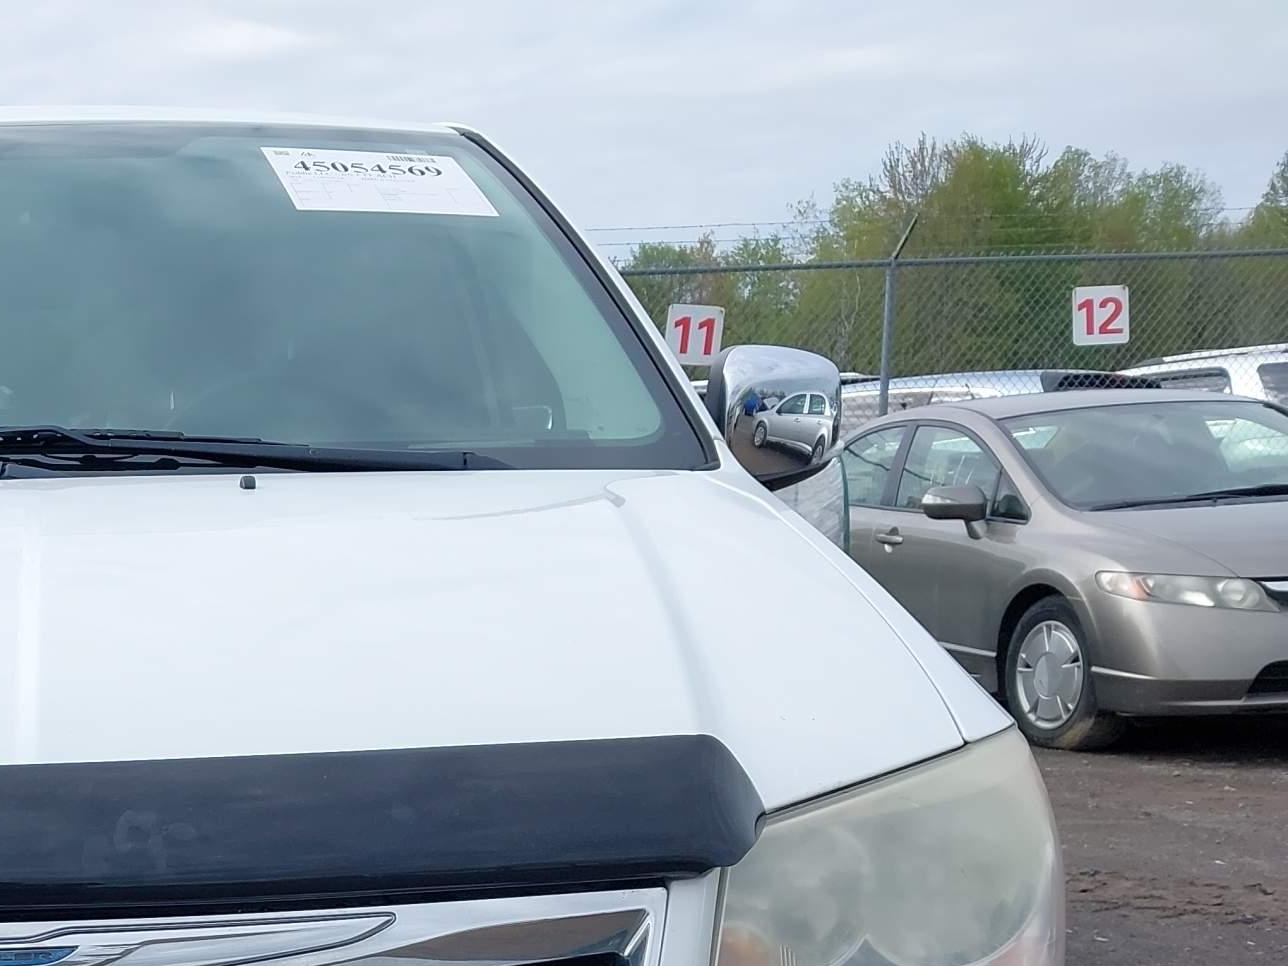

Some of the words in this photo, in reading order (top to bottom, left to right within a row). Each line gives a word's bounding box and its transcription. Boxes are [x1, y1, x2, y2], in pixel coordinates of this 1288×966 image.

[294, 160, 442, 177] 45054569
[1078, 296, 1124, 335] 12
[674, 316, 716, 355] 11
